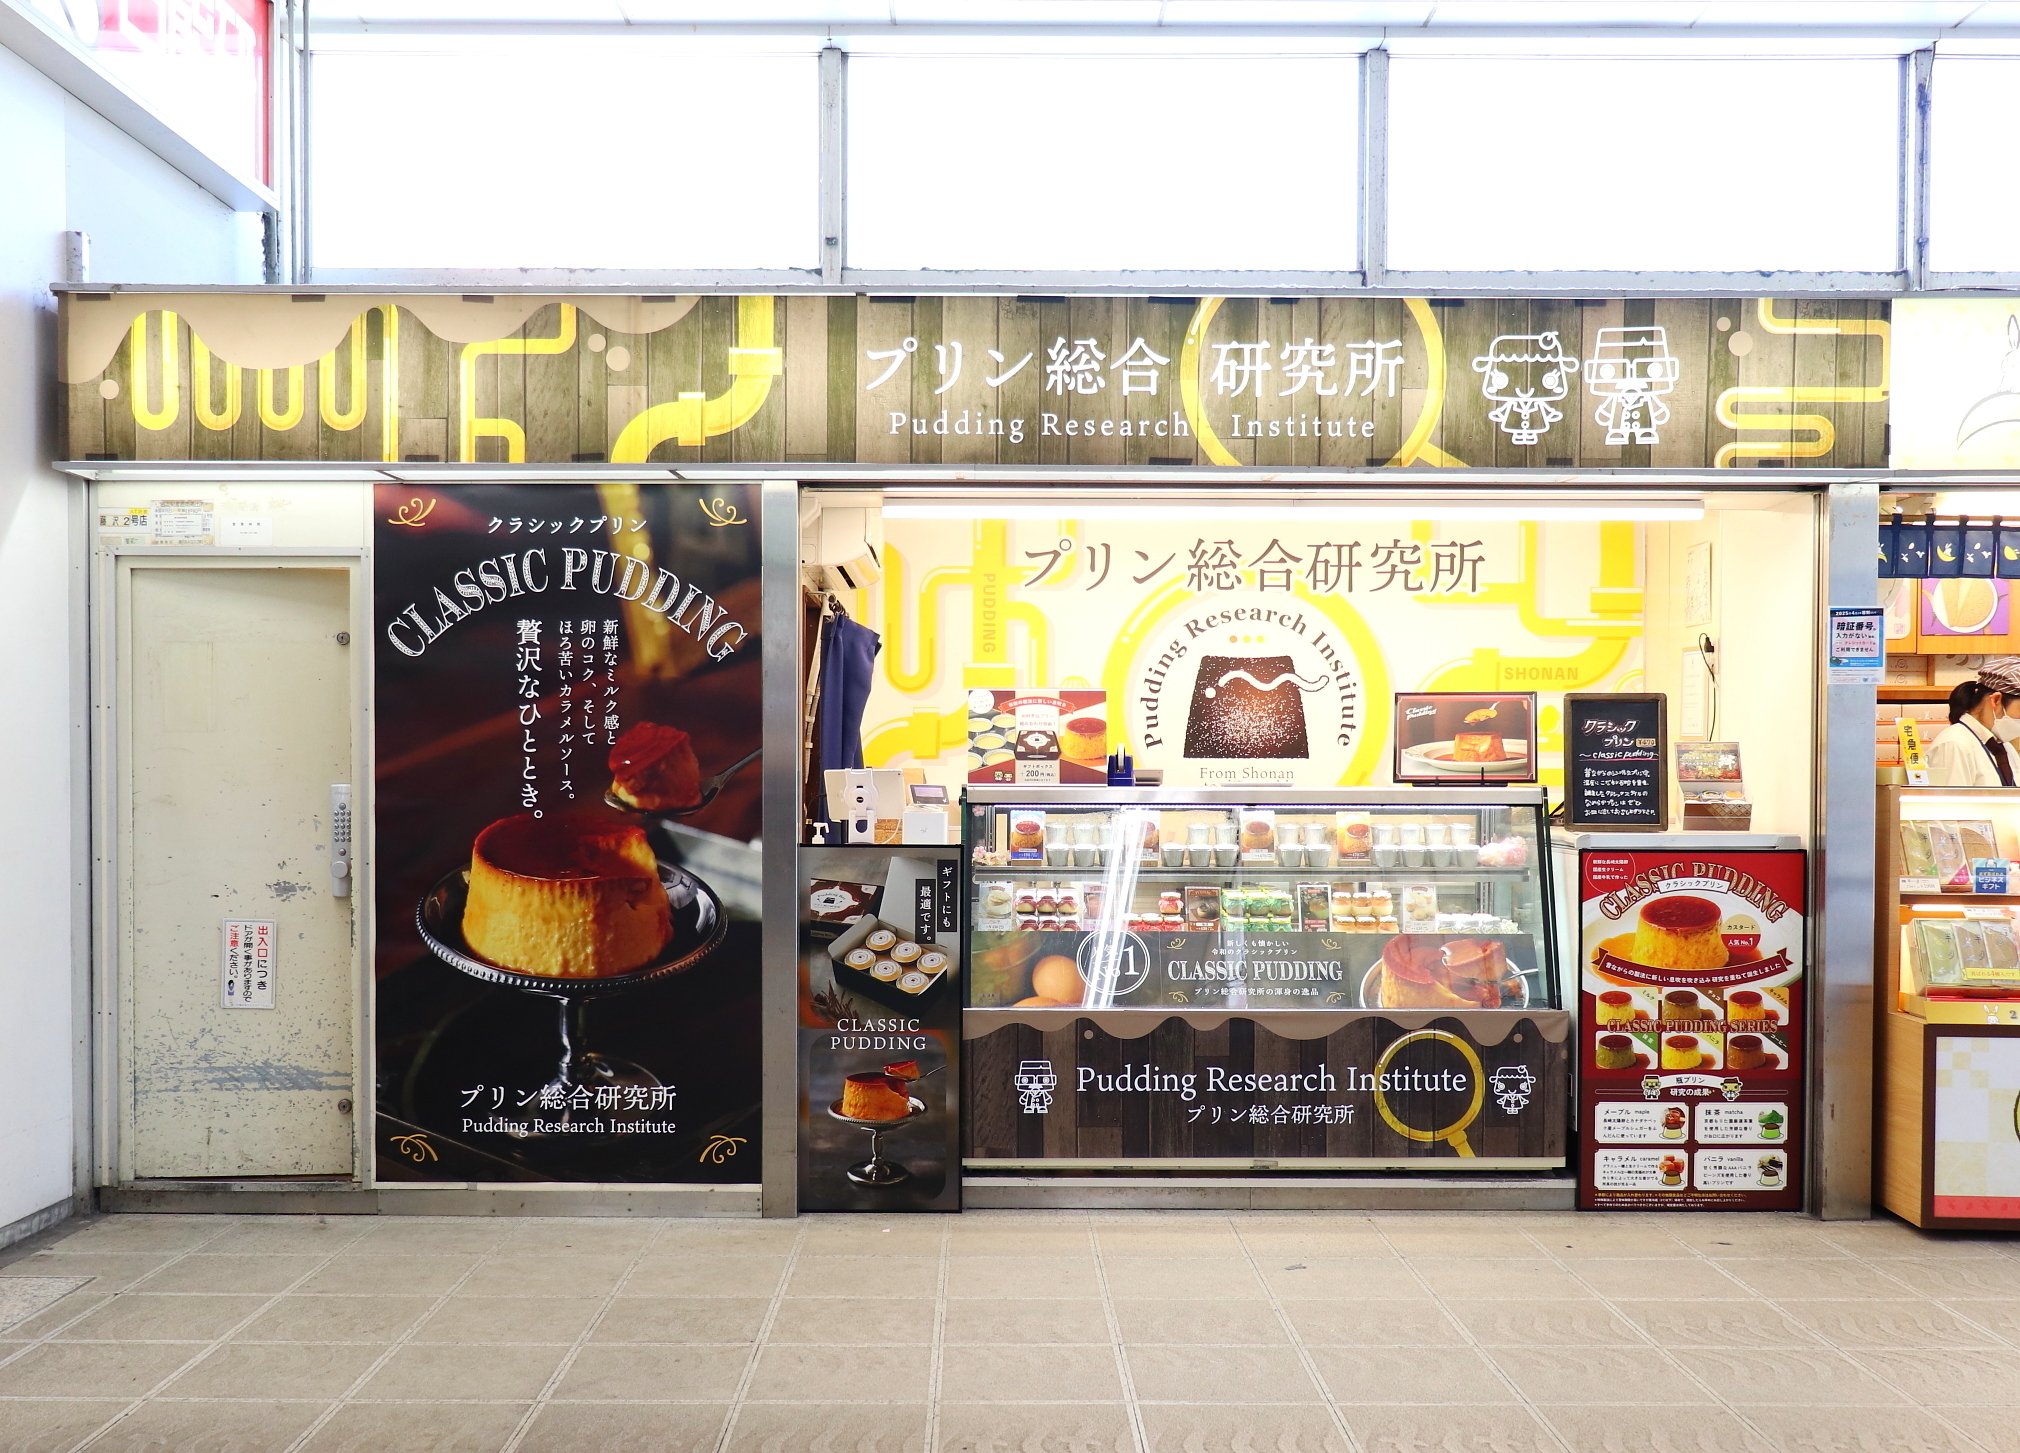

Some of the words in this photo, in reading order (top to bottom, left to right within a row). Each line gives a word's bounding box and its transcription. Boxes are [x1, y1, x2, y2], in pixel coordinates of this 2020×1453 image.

[889, 412, 1025, 443] Pudding
[1041, 412, 1190, 437] Research
[1231, 412, 1376, 438] Institute
[487, 516, 647, 535] クラシックプリン
[1023, 537, 1486, 594] プリン総合研究所
[387, 547, 549, 657] CLASSIC
[560, 547, 748, 662] PUDDING
[983, 573, 996, 653] PUDDING
[580, 619, 597, 745] 卵のコク、そして
[602, 619, 620, 746] 新鮮なミルク感と
[1140, 639, 1187, 750] Pudding
[1183, 606, 1308, 639] Research
[1310, 630, 1357, 747] Institute
[1504, 667, 1579, 681] SHONAN
[516, 619, 543, 820] 贅沢なひととき。
[558, 619, 575, 800] ほろ苦いカラメルソース。
[1584, 720, 1637, 734] クラシック
[1604, 735, 1634, 748] プリン
[1904, 725, 1918, 765] 宅急便
[1200, 767, 1237, 779] From
[1242, 767, 1294, 779] Shonan
[942, 866, 953, 928] ギフトにも
[1665, 880, 1724, 889] クラシックプリン
[919, 886, 932, 941] 最適です。
[229, 924, 240, 979] ご注意ください。
[243, 924, 254, 1003] ドアが開く事がありますので
[257, 925, 268, 991] 出入口につき
[1167, 960, 1248, 981] CLASSIC
[1252, 960, 1343, 981] PUDDING
[1707, 989, 1721, 1001] チョコ
[837, 1018, 920, 1032] CLASSIC
[1607, 1020, 1663, 1033] CLASSIC
[1666, 1020, 1727, 1033] PUDDING
[1730, 1020, 1778, 1033] SERIES
[831, 1037, 927, 1050] PUDDING
[1770, 1034, 1788, 1047] コーヒー
[1076, 1065, 1198, 1100] Pudding
[1205, 1065, 1337, 1093] Research
[1346, 1065, 1467, 1093] Institute
[1670, 1088, 1710, 1096] 研究の成果
[1676, 1076, 1705, 1084] 瓶プリン
[460, 1084, 677, 1112] プリン総合研究所
[462, 1117, 529, 1138] Pudding
[533, 1117, 605, 1134] Research
[610, 1117, 676, 1134] Institute
[1186, 1104, 1355, 1125] プリン総合研究所
